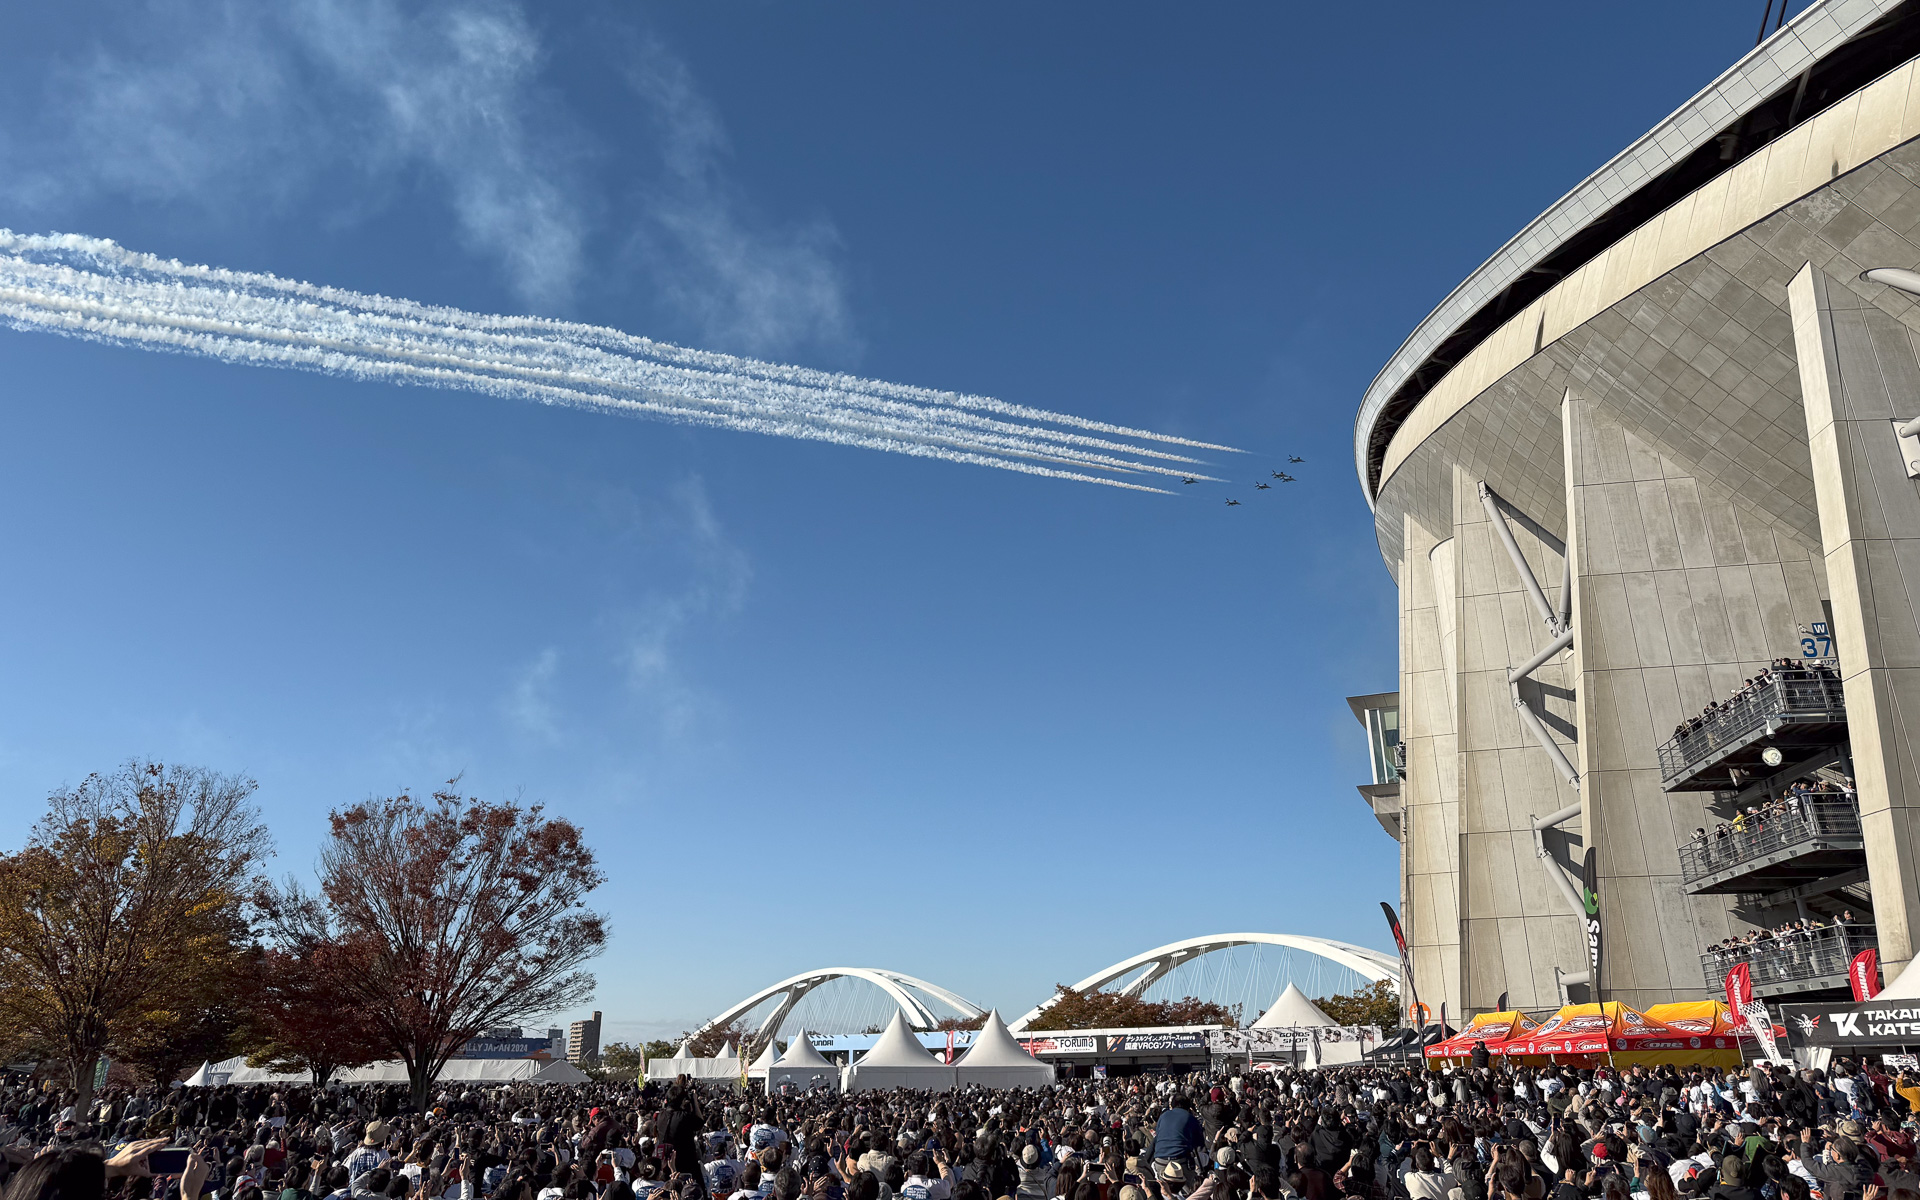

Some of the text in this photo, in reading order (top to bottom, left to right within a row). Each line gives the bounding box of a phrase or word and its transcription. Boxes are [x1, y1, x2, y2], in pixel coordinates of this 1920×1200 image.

[1813, 624, 1825, 634] W
[1801, 637, 1831, 658] 37
[1828, 1012, 1865, 1037] TK
[1868, 1022, 1920, 1037] KATS
[456, 1043, 483, 1052] ALLY
[484, 1043, 511, 1052] JAPAN
[511, 1043, 528, 1052] 2024
